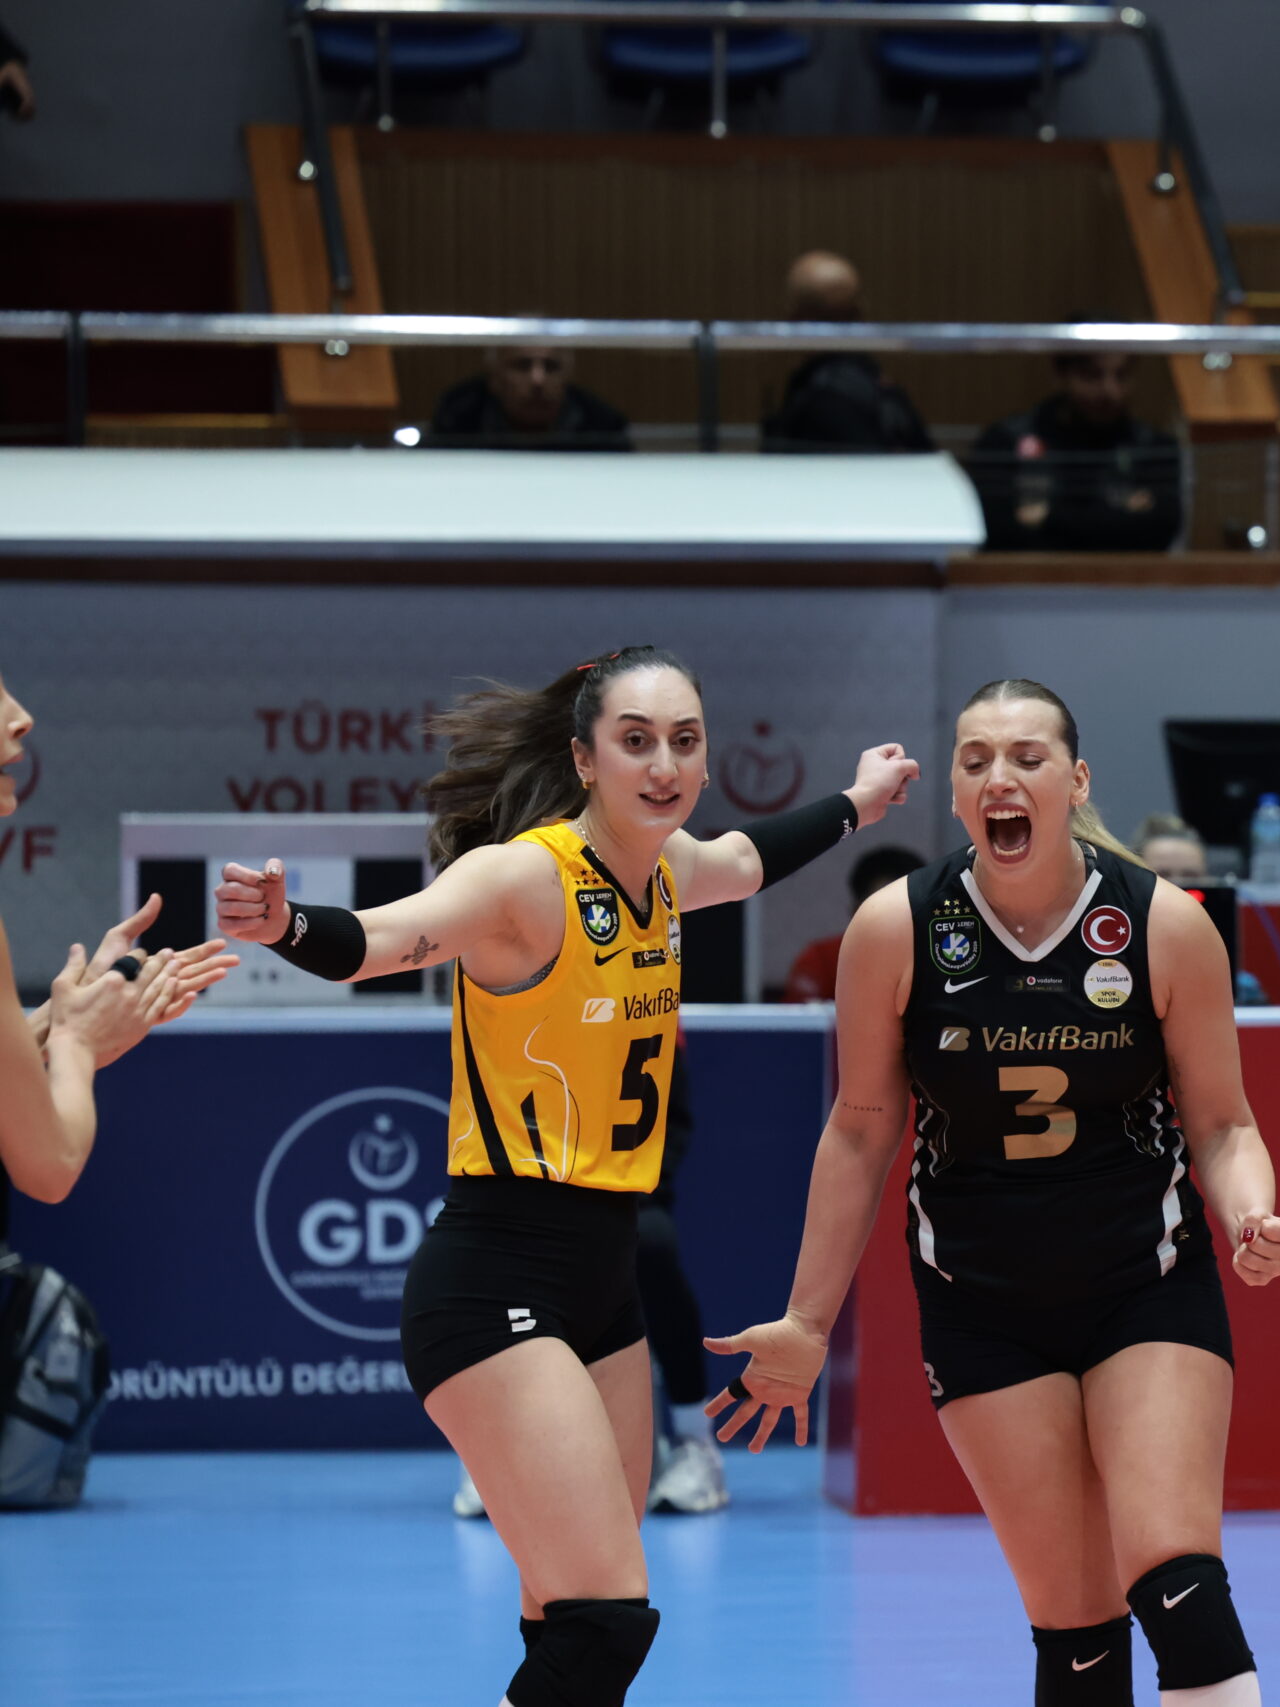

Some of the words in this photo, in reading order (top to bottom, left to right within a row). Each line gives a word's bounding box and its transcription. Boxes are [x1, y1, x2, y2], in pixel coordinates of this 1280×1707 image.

[256, 699, 437, 753] TÜRKİ
[227, 777, 432, 813] VOLEY
[579, 893, 595, 903] CEV
[935, 922, 955, 932] CEV
[623, 987, 680, 1021] VakıfBa
[982, 1023, 1136, 1052] VakıfBank
[611, 1033, 664, 1152] 5
[998, 1065, 1077, 1161] 3
[106, 1357, 284, 1400] RÜNTÜLÜ
